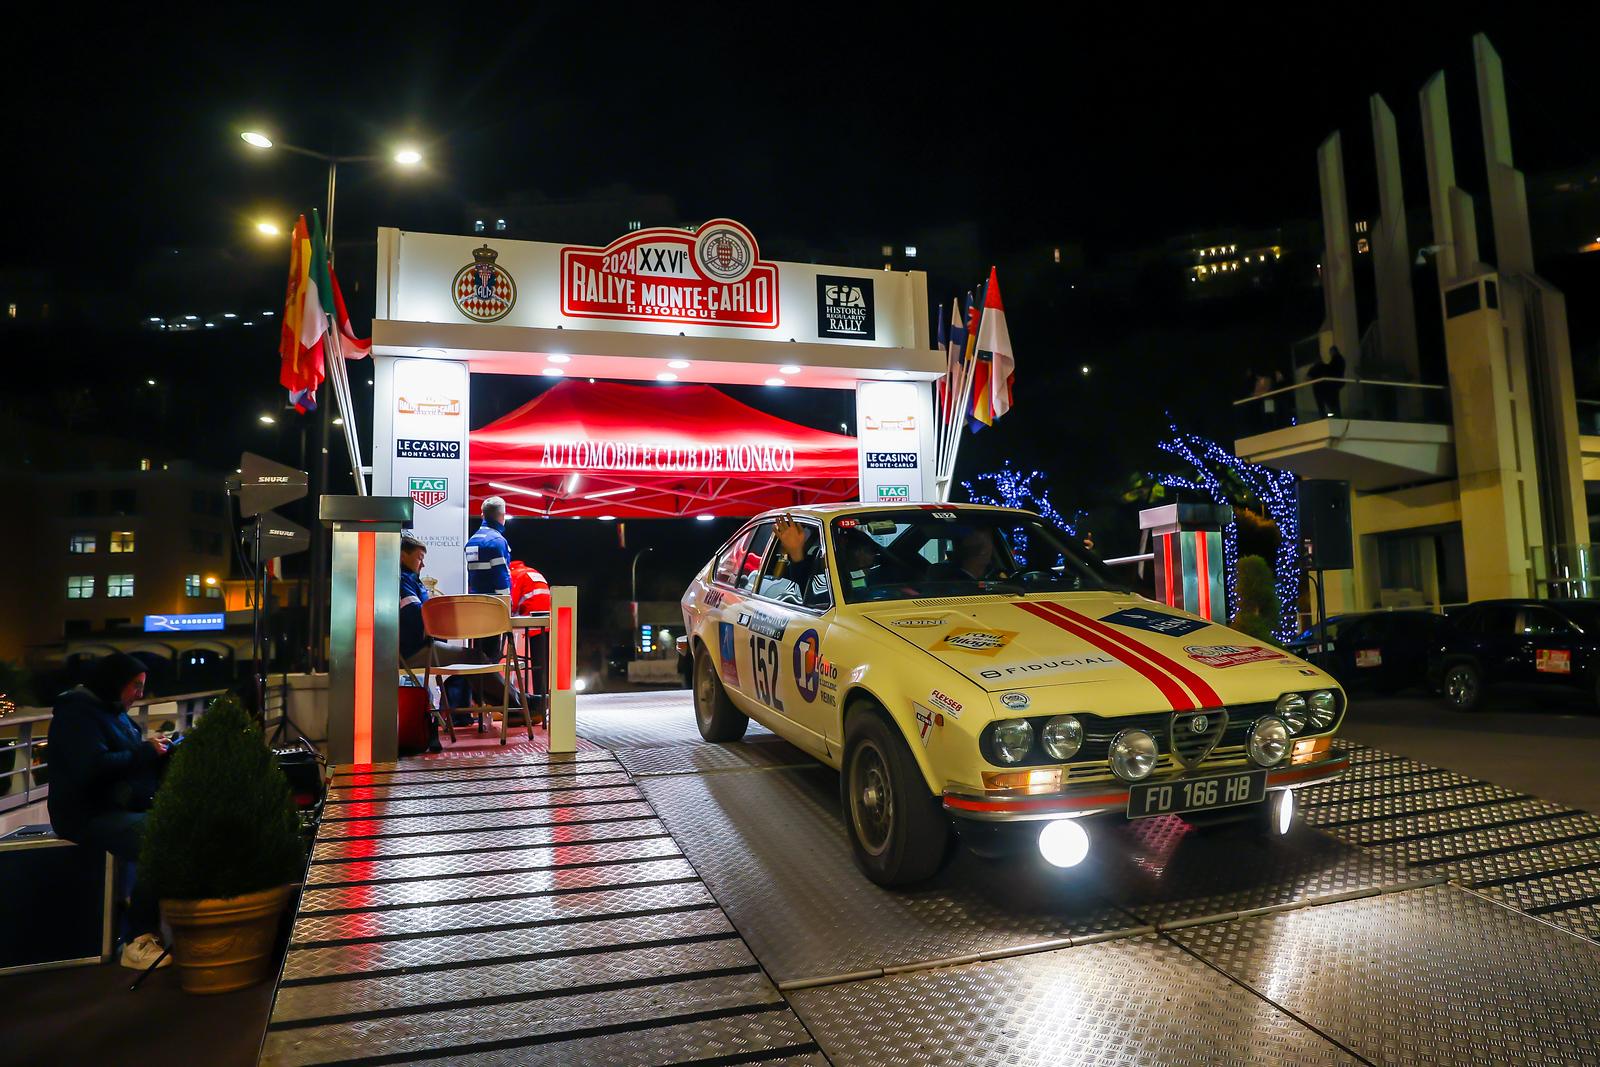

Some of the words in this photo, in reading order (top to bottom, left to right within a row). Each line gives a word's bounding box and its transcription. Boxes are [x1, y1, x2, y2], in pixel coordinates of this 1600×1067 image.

[602, 248, 635, 274] 2024
[573, 260, 636, 304] RALLYE
[641, 276, 768, 313] MONTE-CARLO
[627, 304, 717, 318] HISTORIQUE
[826, 306, 866, 316] HISTORIC
[826, 313, 866, 321] REGULARITY
[830, 318, 862, 331] RALLY
[398, 441, 410, 450] LE
[412, 441, 459, 452] CASINO
[539, 440, 651, 471] AUTOMOBILE
[655, 443, 697, 472] CLUB
[700, 444, 722, 472] DE
[724, 444, 794, 472] MONACO
[867, 453, 877, 462] LE
[878, 453, 916, 462] CASINO
[412, 480, 444, 490] TAG
[880, 487, 906, 496] TAG
[411, 491, 445, 507] HEUER
[269, 529, 295, 537] SHURE
[943, 635, 1005, 648] Villages
[1005, 656, 1114, 675] FIDUCIAL
[749, 634, 785, 712] 152
[1145, 785, 1172, 813] FD
[1183, 779, 1219, 808] 166
[1224, 775, 1250, 803] HB
